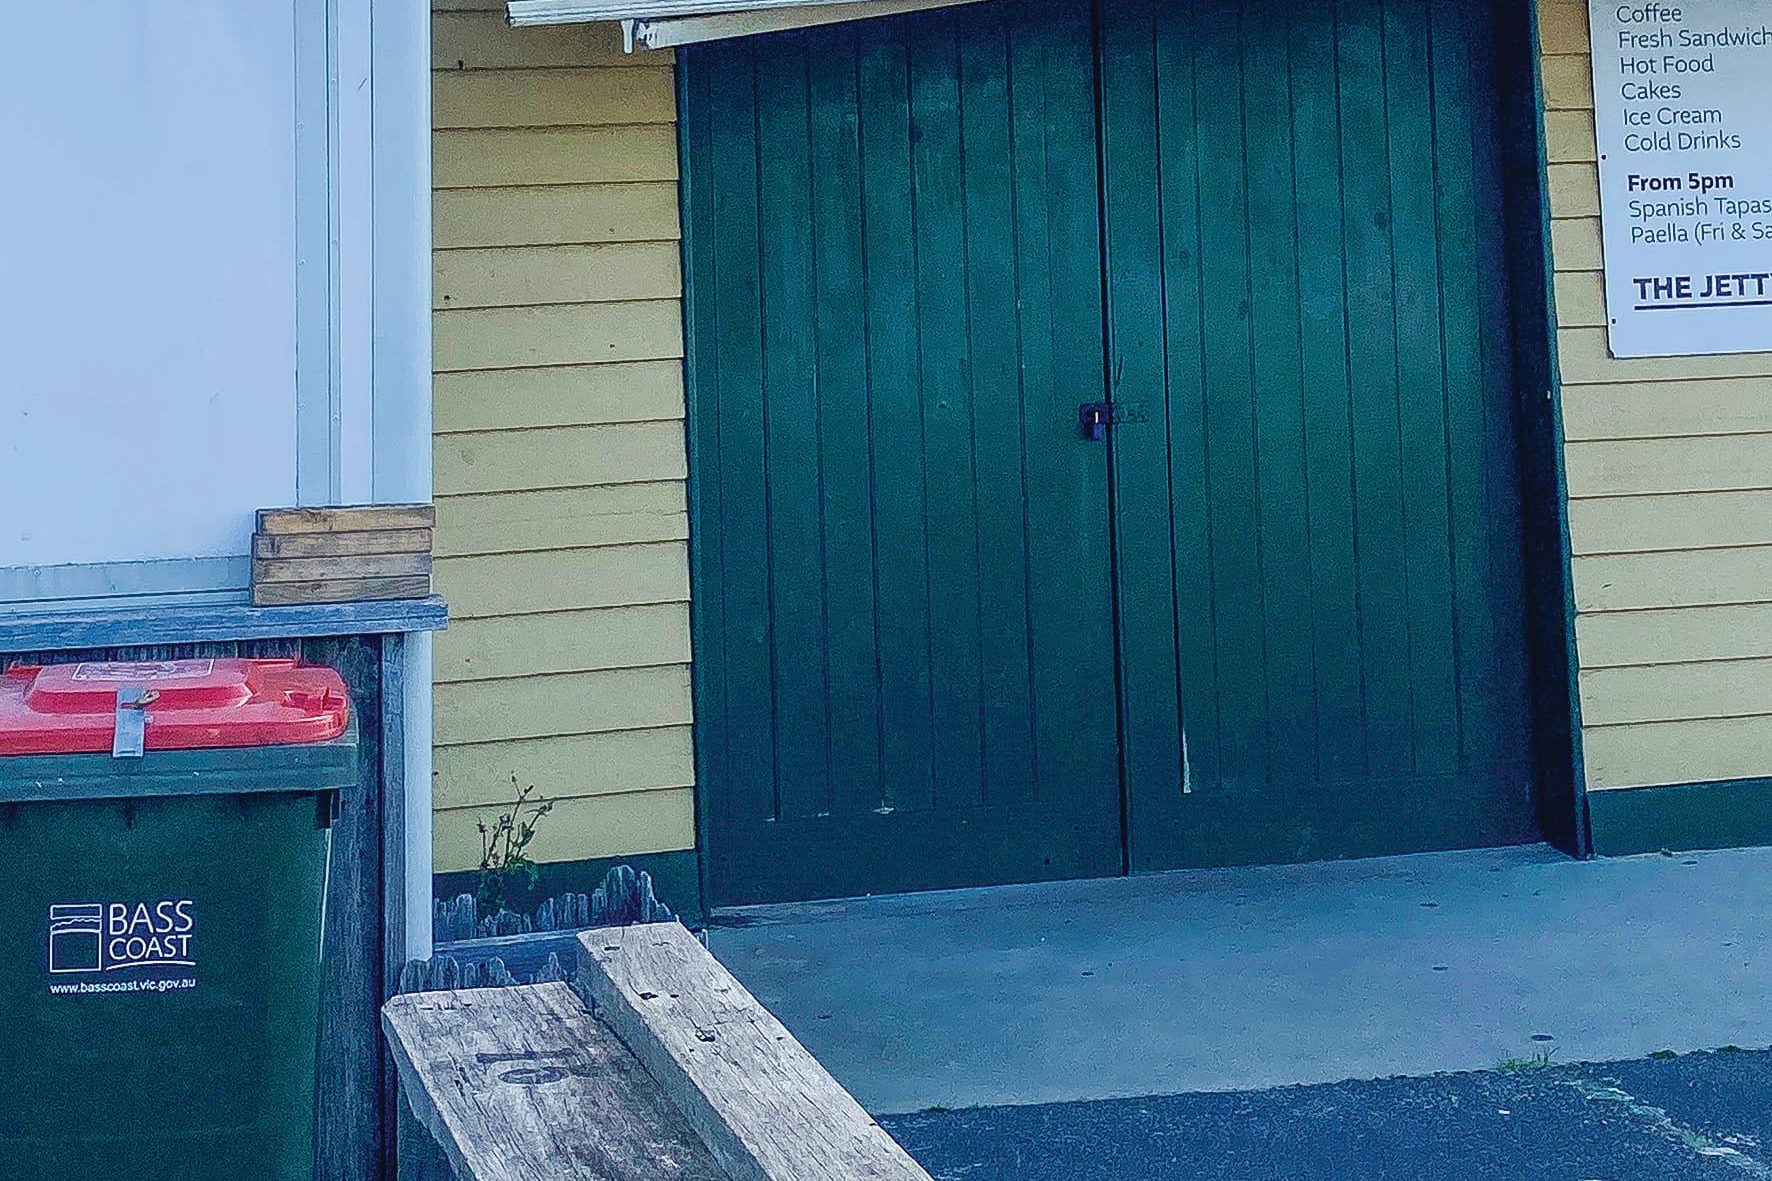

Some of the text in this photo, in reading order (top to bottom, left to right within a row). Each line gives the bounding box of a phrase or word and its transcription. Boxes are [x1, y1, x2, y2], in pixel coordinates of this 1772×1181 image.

[1616, 2, 1682, 23] Coffee
[1618, 25, 1772, 49] Fresh Sandwich
[1620, 52, 1715, 74] Hot Food
[1621, 79, 1681, 100] Cakes
[1623, 107, 1722, 126] Ice Cream
[1624, 129, 1741, 151] Cold Drinks
[1627, 172, 1734, 194] From 5pm
[1628, 195, 1772, 222] Spanish Tapas
[1631, 222, 1688, 243] Paella
[1694, 221, 1725, 246] (Fri
[1731, 222, 1746, 240] &
[1632, 272, 1772, 300] THE JETT
[109, 900, 193, 935] BASS
[109, 934, 193, 960] COAST
[50, 978, 196, 994] www.basscoast.vic.gov.au
